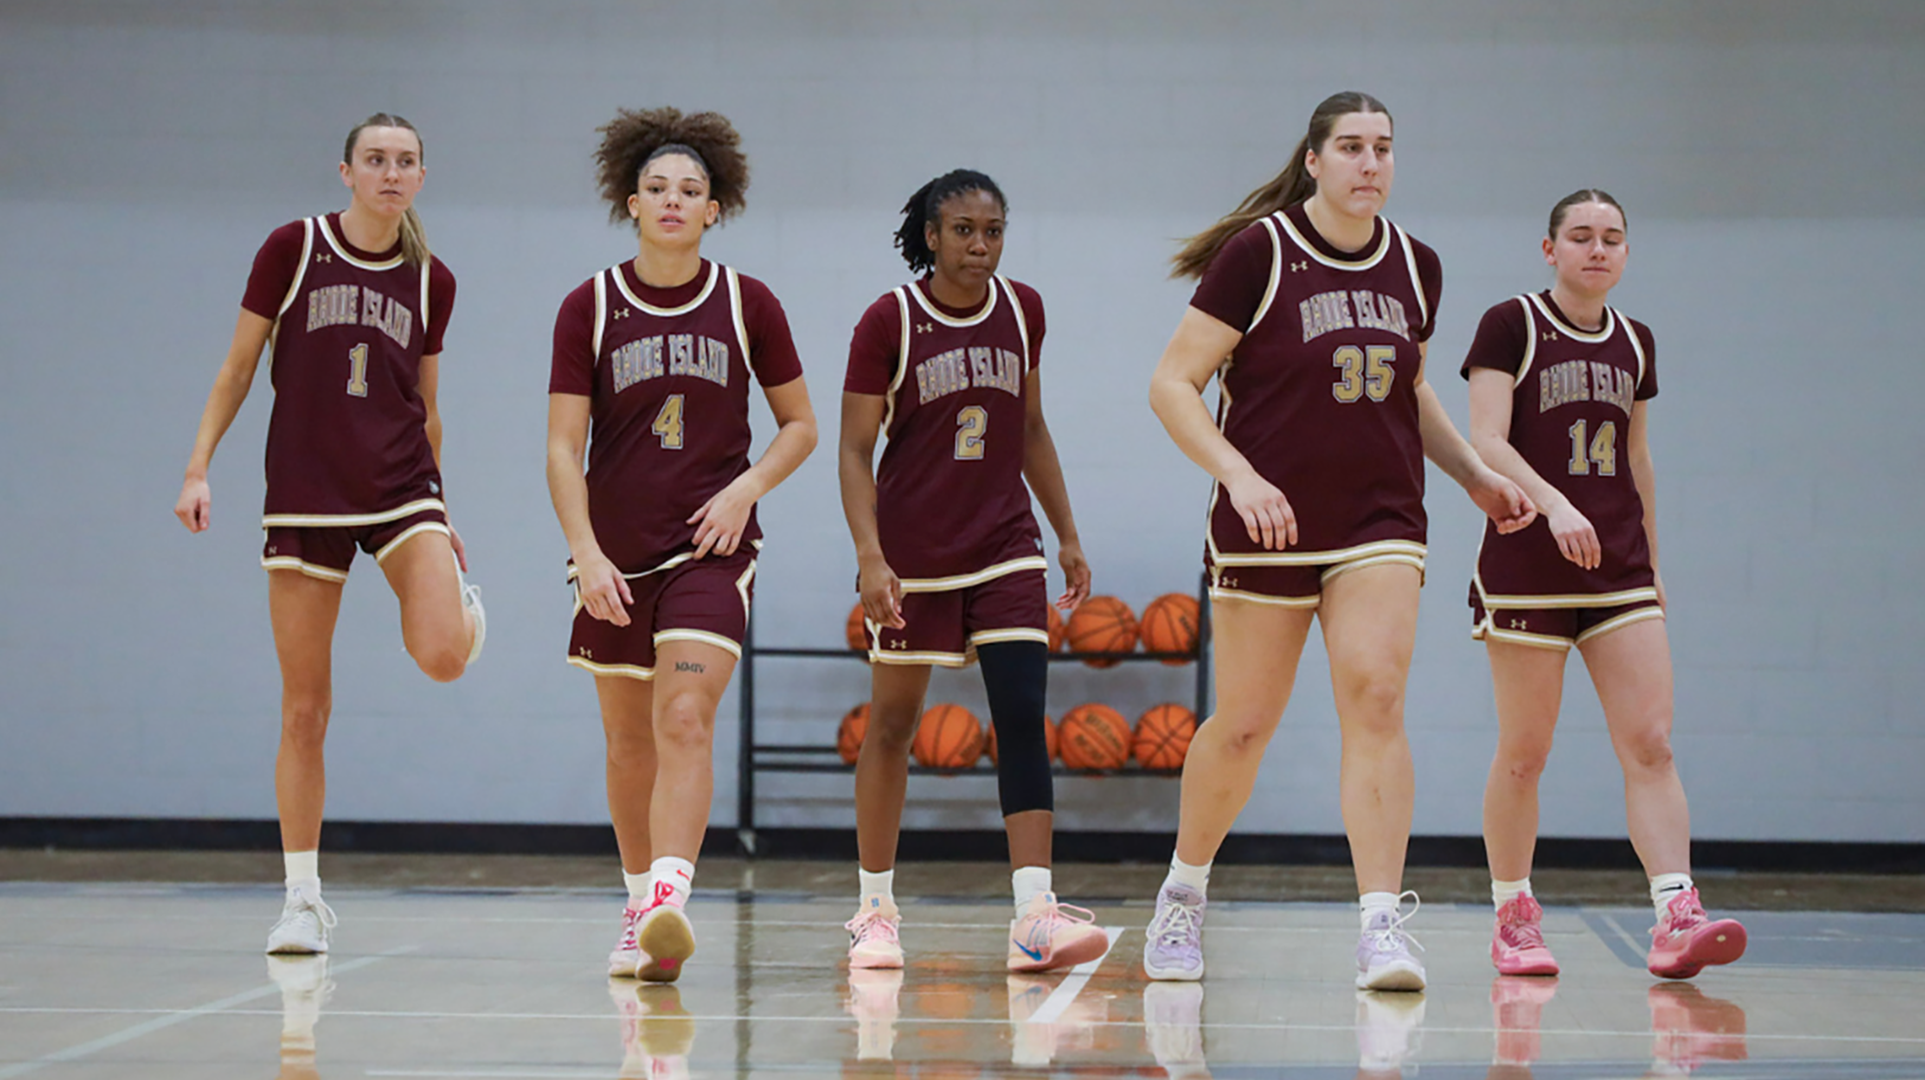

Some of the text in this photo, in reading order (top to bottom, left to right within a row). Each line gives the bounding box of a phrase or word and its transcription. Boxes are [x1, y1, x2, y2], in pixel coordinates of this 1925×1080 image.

[307, 284, 413, 350] RHODE ISLAND
[1299, 290, 1411, 343] RHODE ISLAND
[347, 343, 369, 398] 1
[611, 334, 729, 394] RHODE ISLAND
[915, 347, 1020, 405] RHODE ISLAND
[1332, 345, 1396, 403] 35
[1539, 360, 1634, 419] RHODE ISLAND
[652, 394, 685, 449] 4
[954, 405, 988, 460] 2
[1568, 418, 1616, 476] 14
